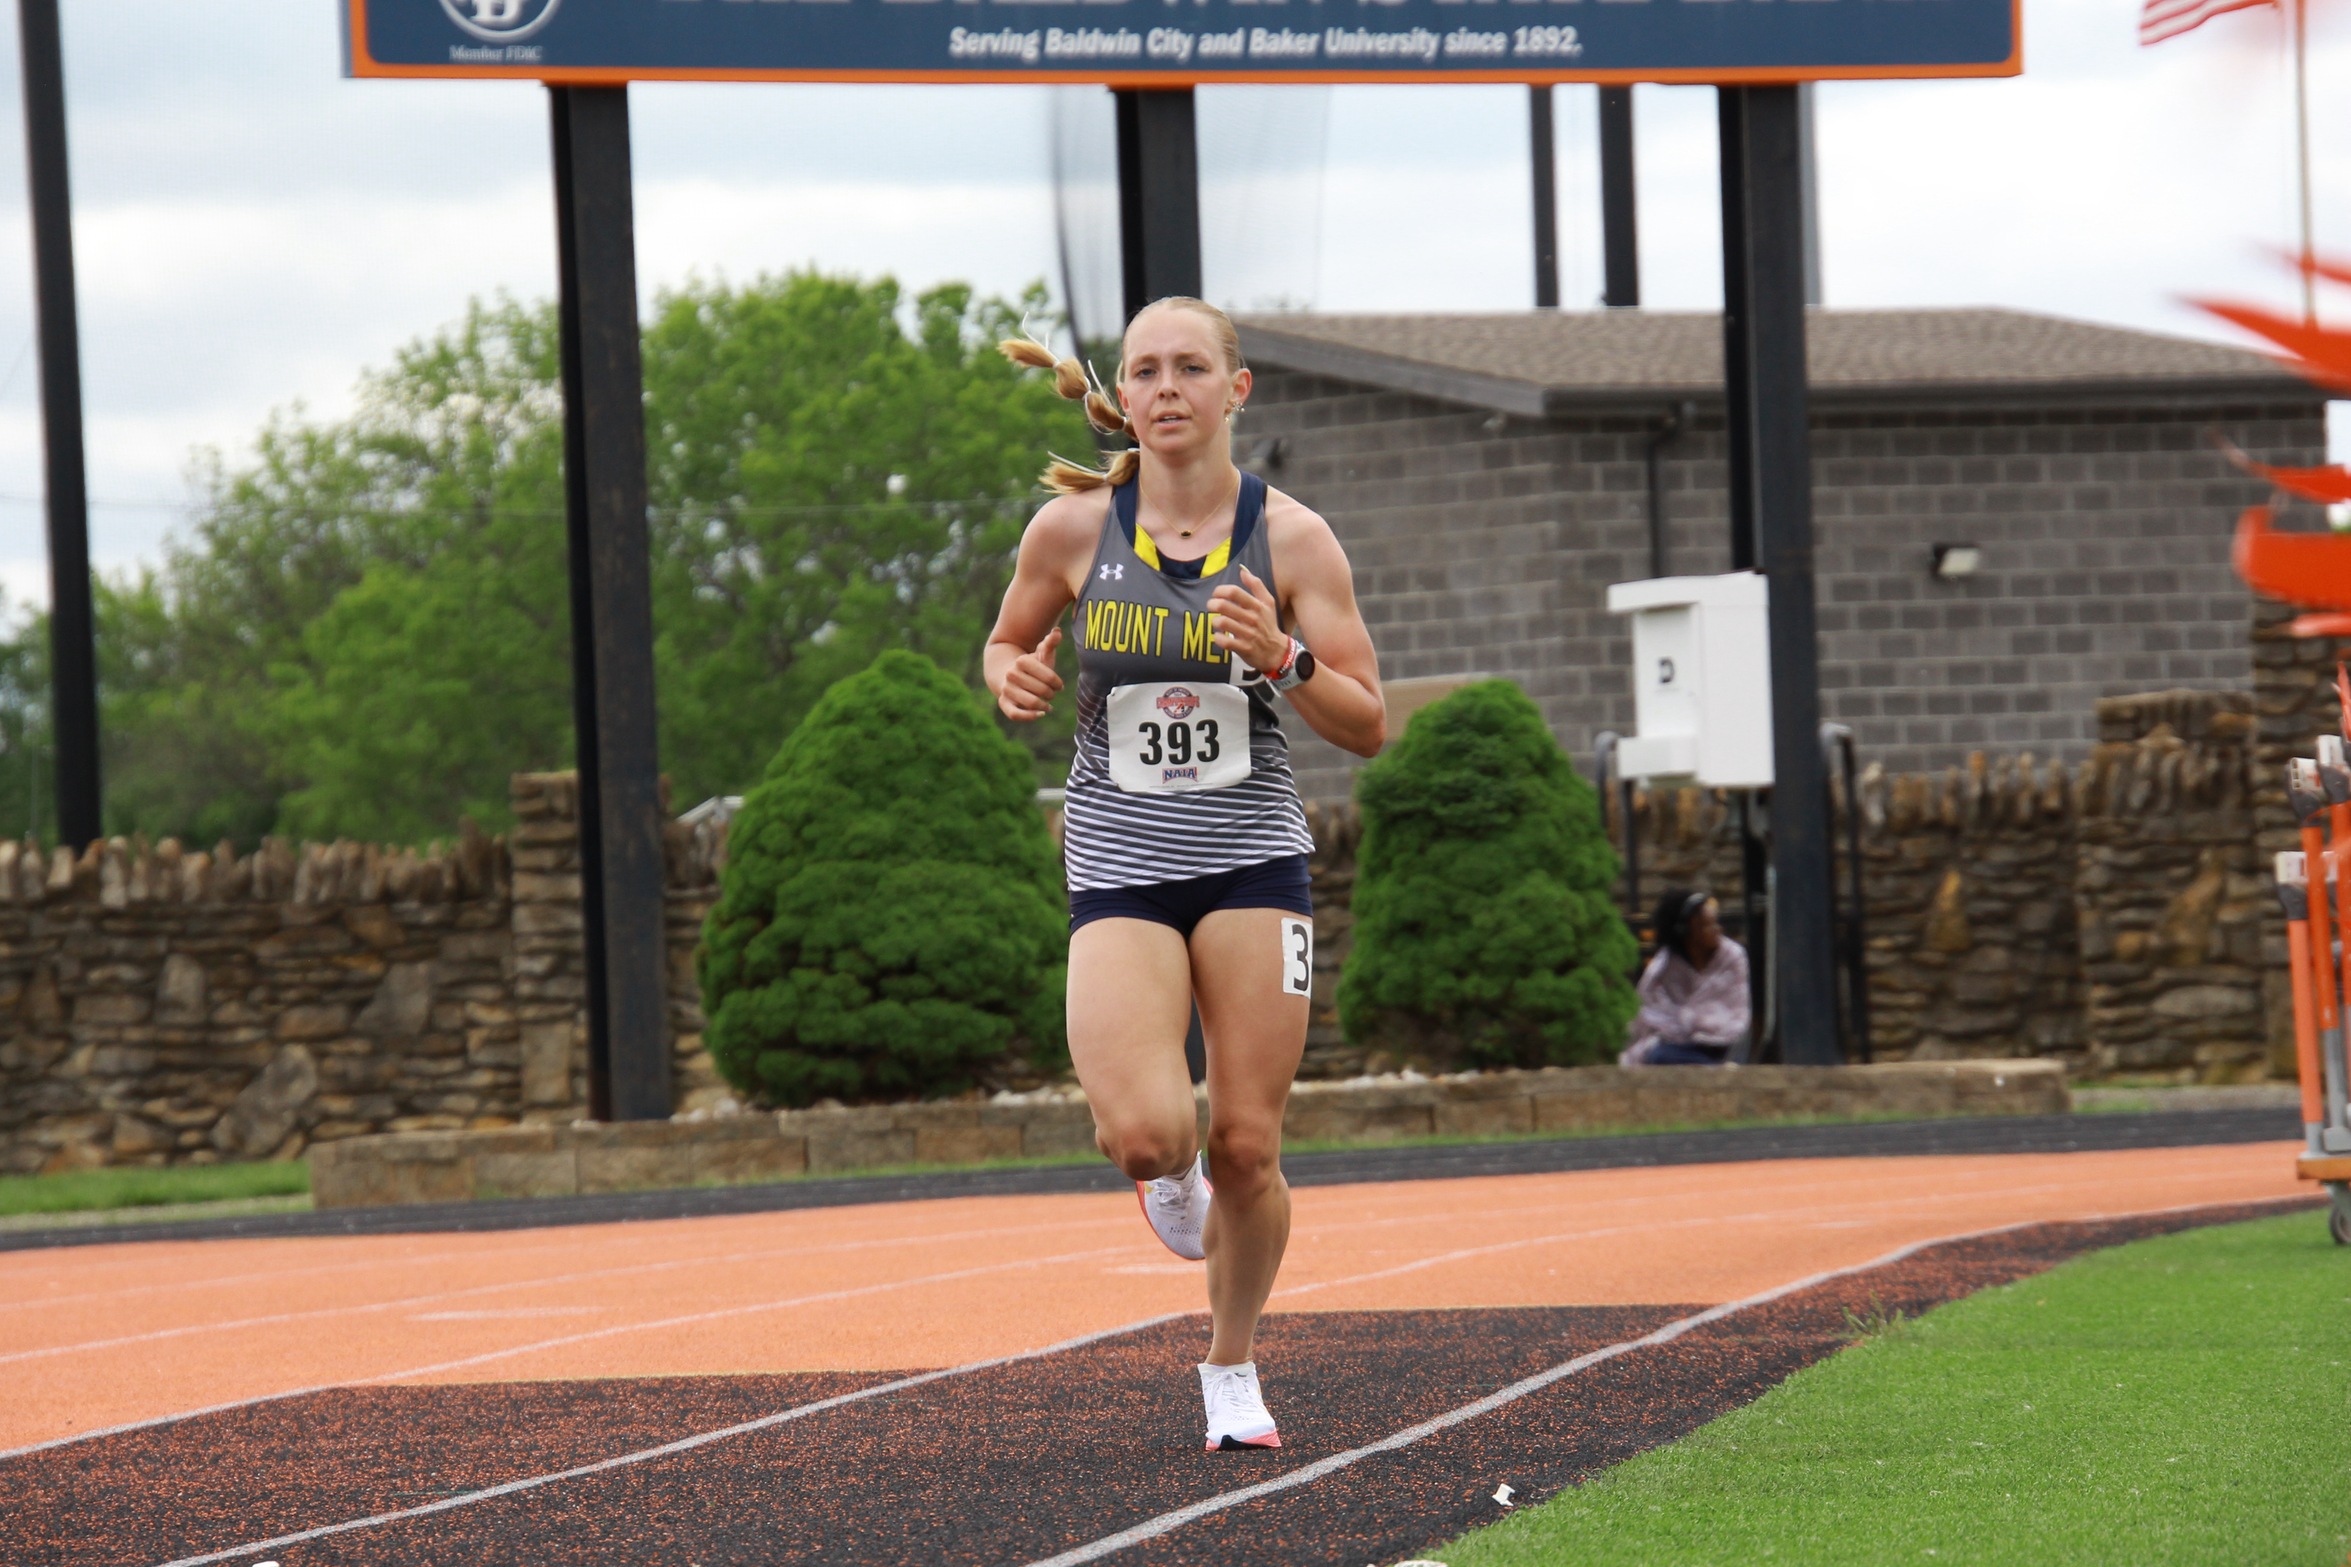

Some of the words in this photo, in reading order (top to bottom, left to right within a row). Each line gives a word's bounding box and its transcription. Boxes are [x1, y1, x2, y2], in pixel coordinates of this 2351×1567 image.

[949, 27, 1040, 62] Serving
[1045, 27, 1142, 55] Baldwin
[1146, 27, 1194, 62] City
[1198, 27, 1246, 55] and
[1249, 27, 1320, 55] Baker
[1323, 26, 1441, 61] University
[1444, 27, 1508, 53] since
[1512, 25, 1583, 55] 1892.
[1084, 599, 1170, 658] MOUNT
[1138, 718, 1220, 765] 393
[1164, 768, 1196, 780] NAIA
[1291, 923, 1310, 992] 3
